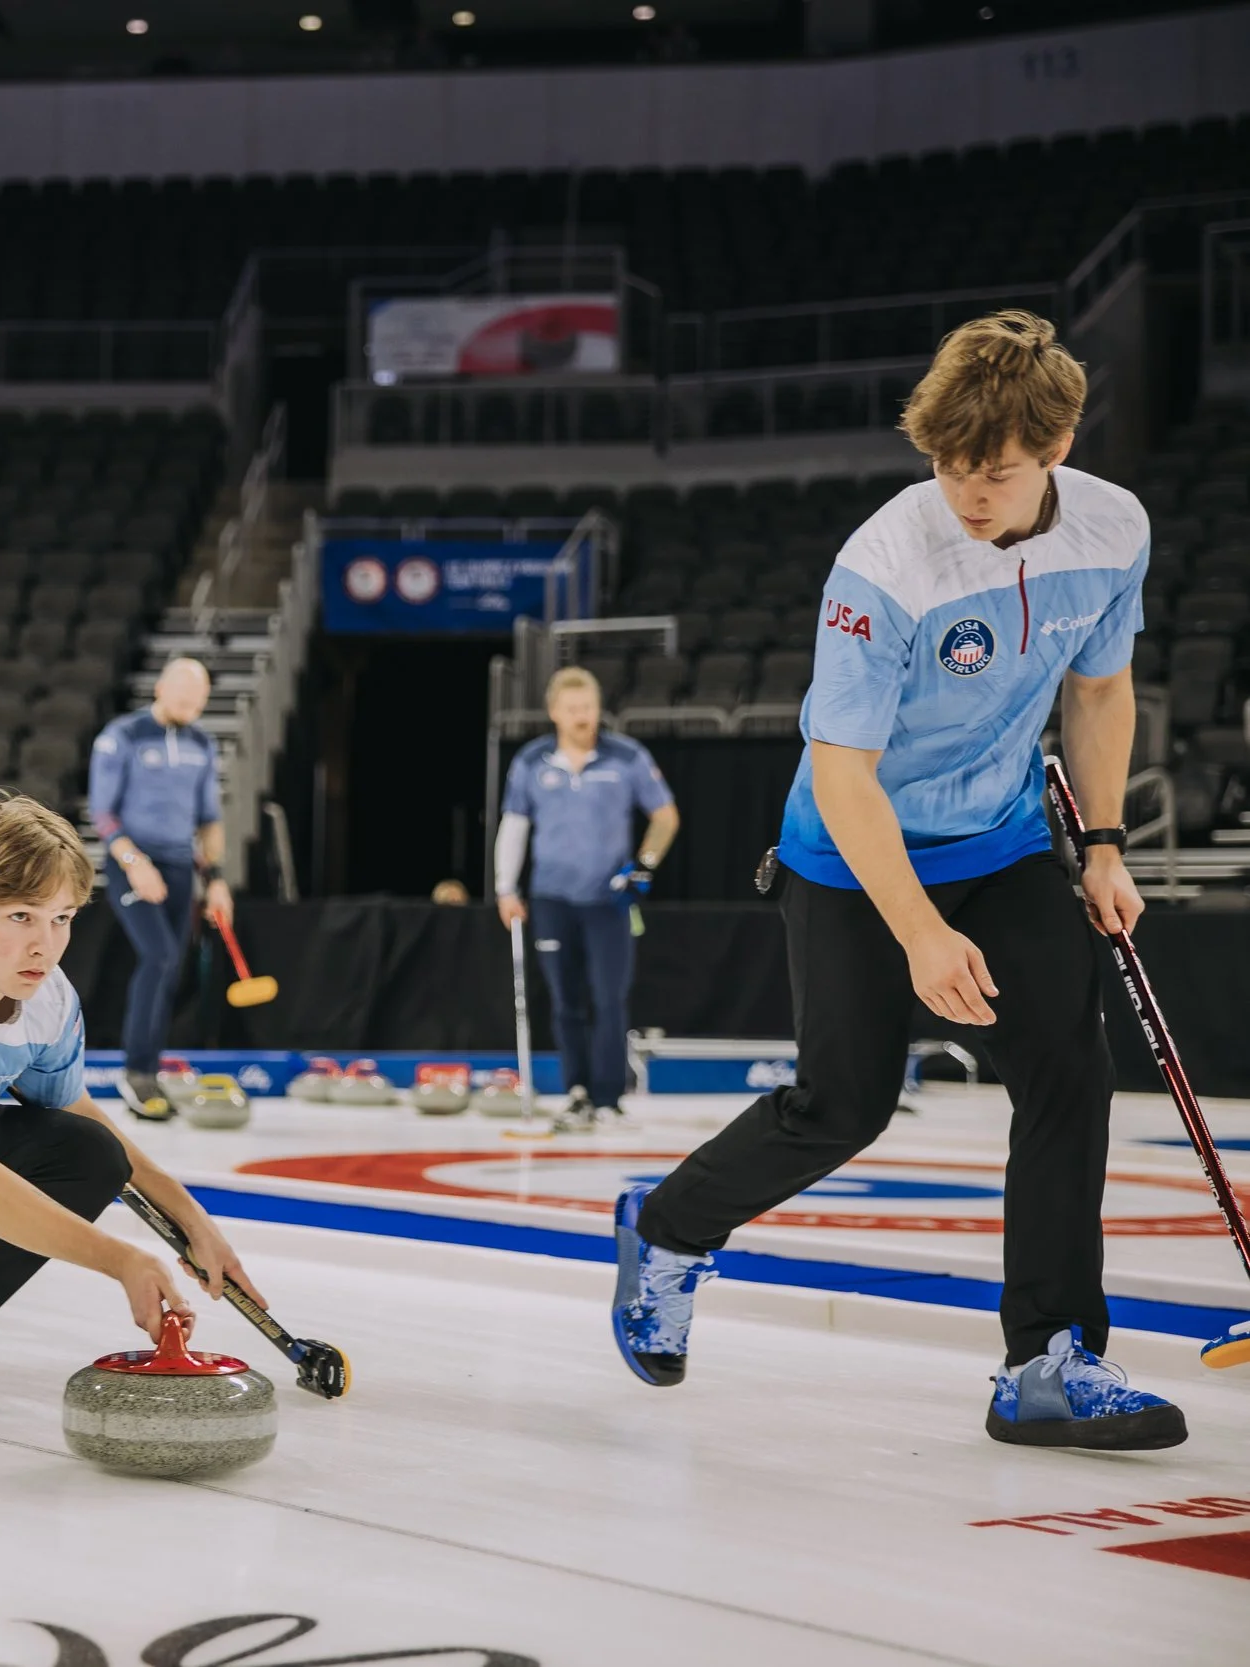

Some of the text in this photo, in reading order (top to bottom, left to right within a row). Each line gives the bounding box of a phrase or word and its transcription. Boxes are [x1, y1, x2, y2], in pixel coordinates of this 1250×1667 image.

[826, 599, 872, 642] USA
[955, 621, 980, 634] USA
[942, 654, 992, 675] CURLING
[222, 1279, 284, 1339] oldline
[964, 1507, 1164, 1537] ALL
